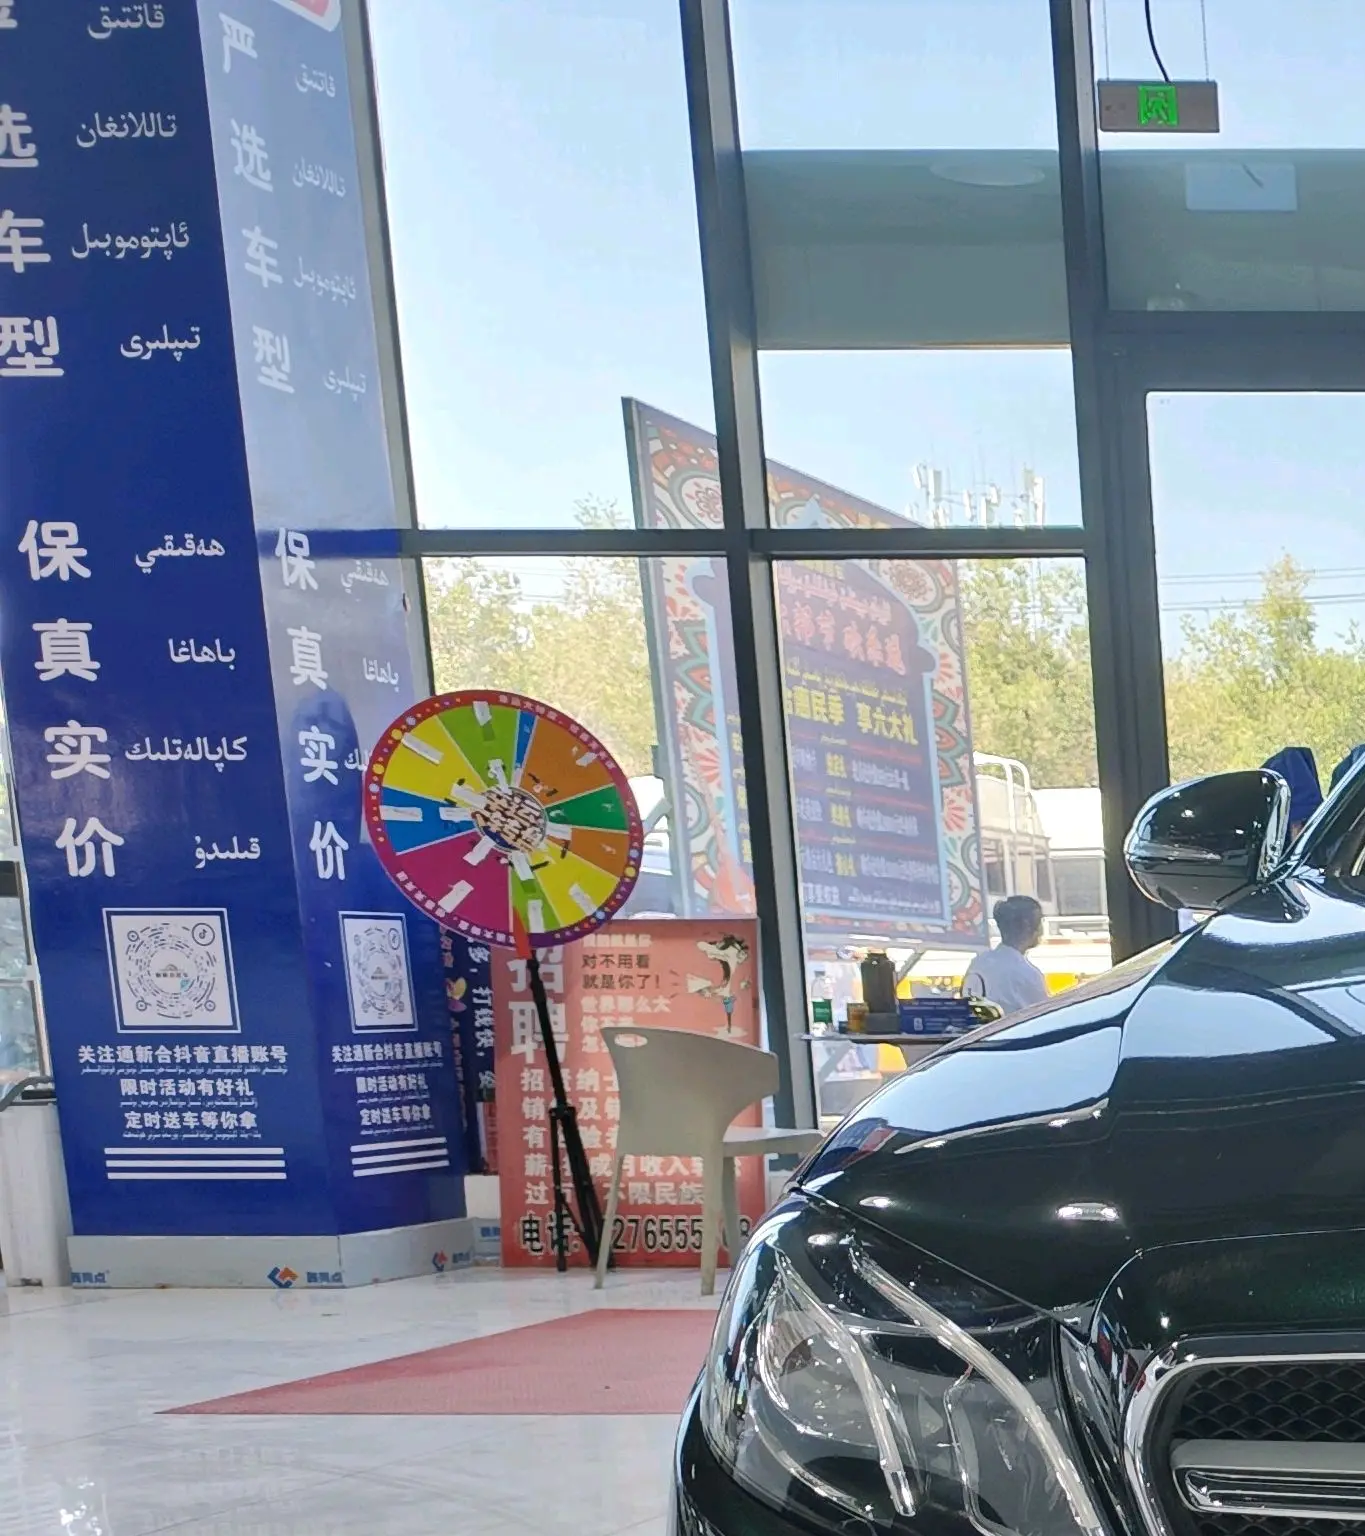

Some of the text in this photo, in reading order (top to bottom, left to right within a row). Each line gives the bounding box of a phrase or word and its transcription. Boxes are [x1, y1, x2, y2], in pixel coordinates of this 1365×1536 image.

[88, 3, 164, 38] قاتتىق
[76, 112, 177, 147] تاللانغان
[0, 0, 63, 376] 选车型
[71, 222, 190, 260] ئاپتوموبىل
[168, 638, 235, 670] باھاغا
[18, 520, 124, 877] 保真实价
[275, 527, 348, 881] 保真实价
[125, 737, 247, 772] كاپالەتلىك
[582, 954, 650, 969] 对不用看
[78, 1045, 288, 1064] 关注通新合抖音直播账号
[120, 1078, 254, 1096] 限时活动有好礼
[124, 1111, 257, 1129] 定时送车等你拿
